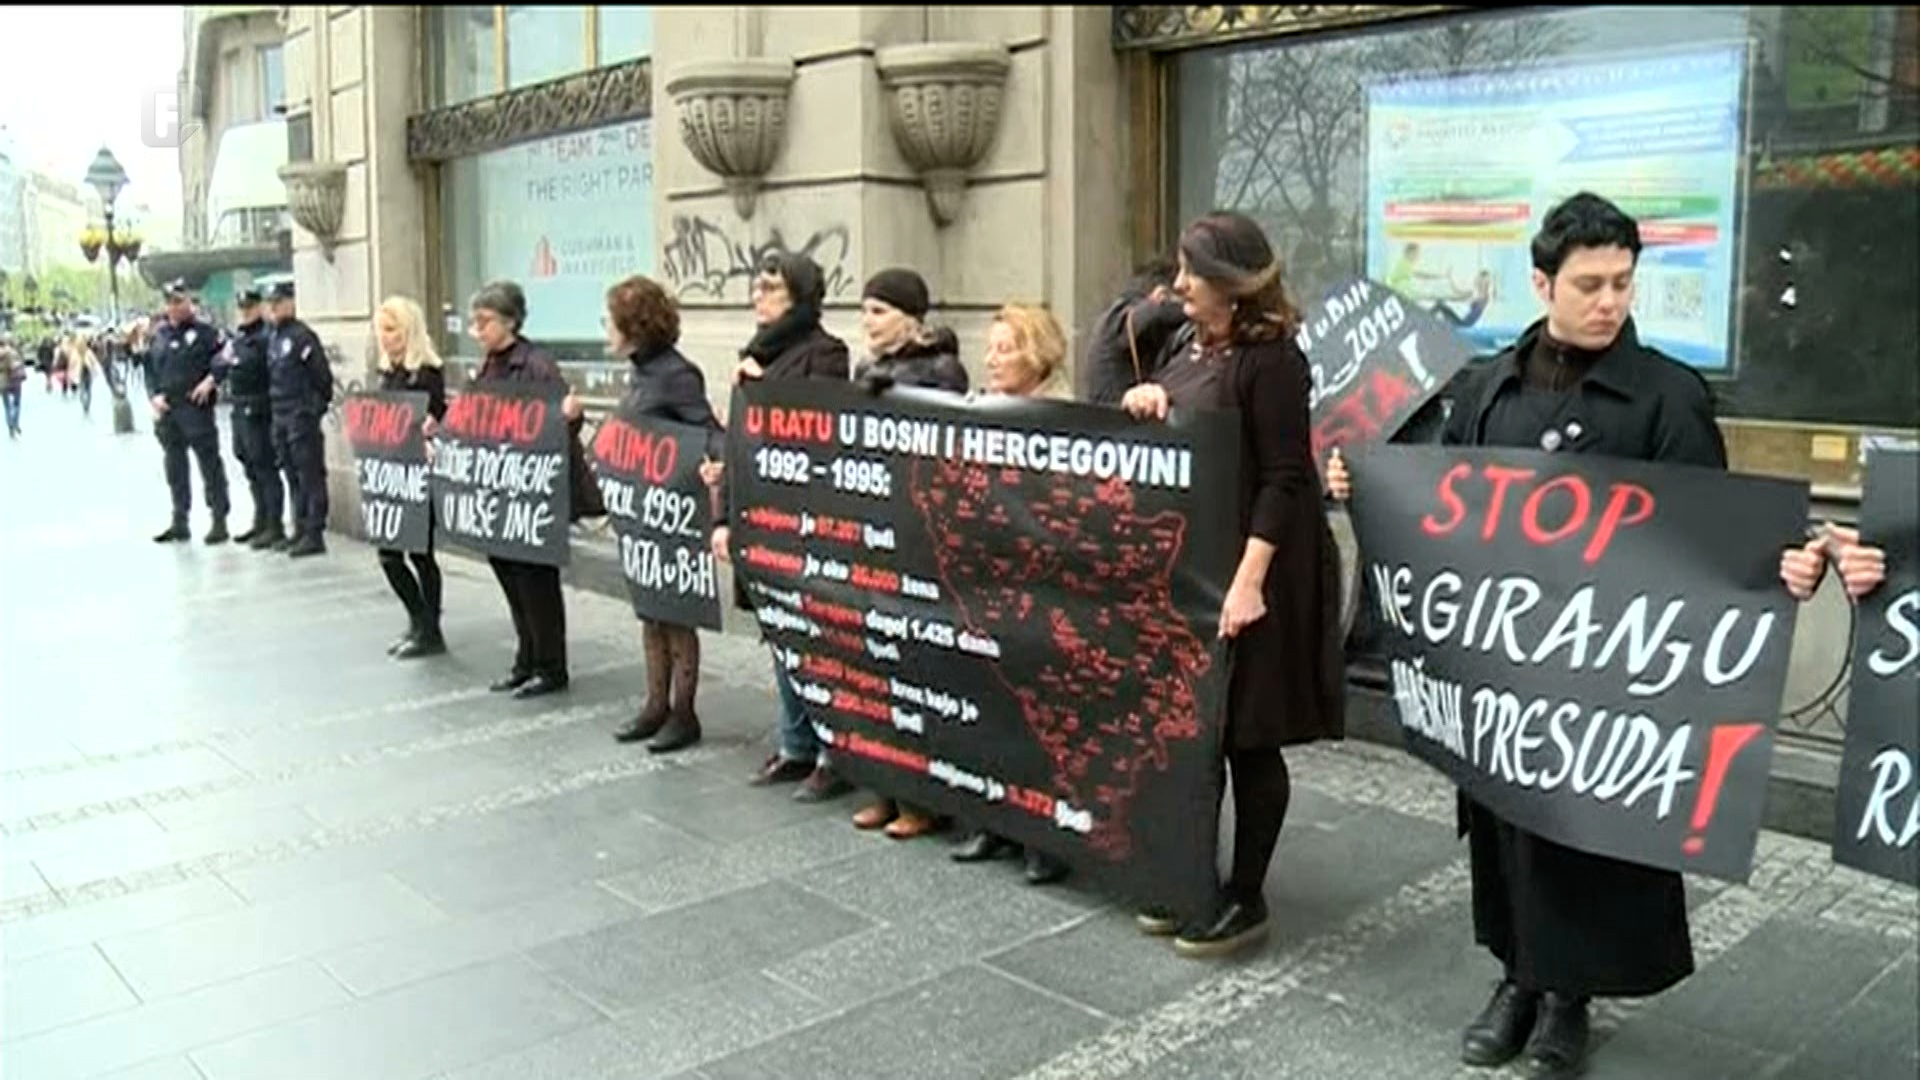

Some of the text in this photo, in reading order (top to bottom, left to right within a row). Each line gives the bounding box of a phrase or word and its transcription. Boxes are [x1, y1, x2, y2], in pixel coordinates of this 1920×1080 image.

[527, 178, 558, 201] THE
[747, 407, 1192, 489] U RATU U BOSNI I HERCEGOVINI
[755, 447, 811, 484] 1992
[831, 457, 892, 497] 1995:
[643, 485, 703, 538] 1992.
[1421, 463, 1654, 565] STOP
